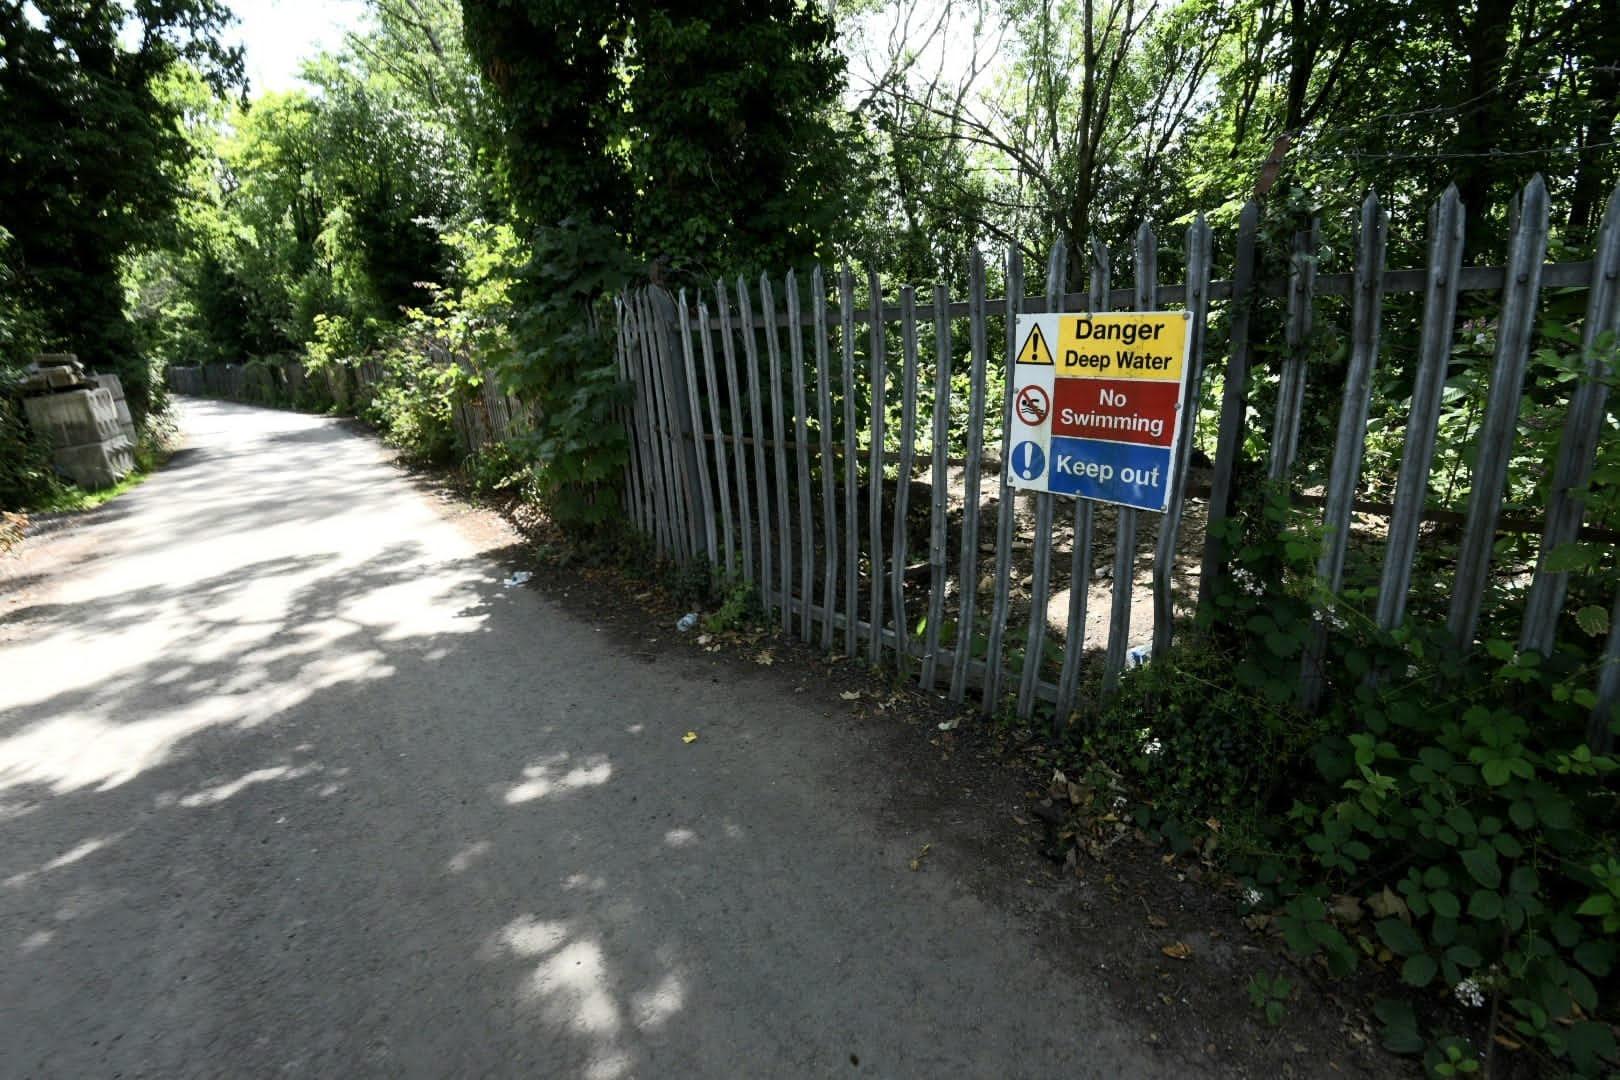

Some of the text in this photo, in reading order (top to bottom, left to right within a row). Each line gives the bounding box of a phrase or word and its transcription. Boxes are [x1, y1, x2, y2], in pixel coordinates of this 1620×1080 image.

[1075, 319, 1165, 345] Danger
[1065, 350, 1172, 371] Deep Water
[1099, 388, 1127, 407] No
[1060, 408, 1164, 437] Swimming
[1056, 454, 1160, 487] Keep out
